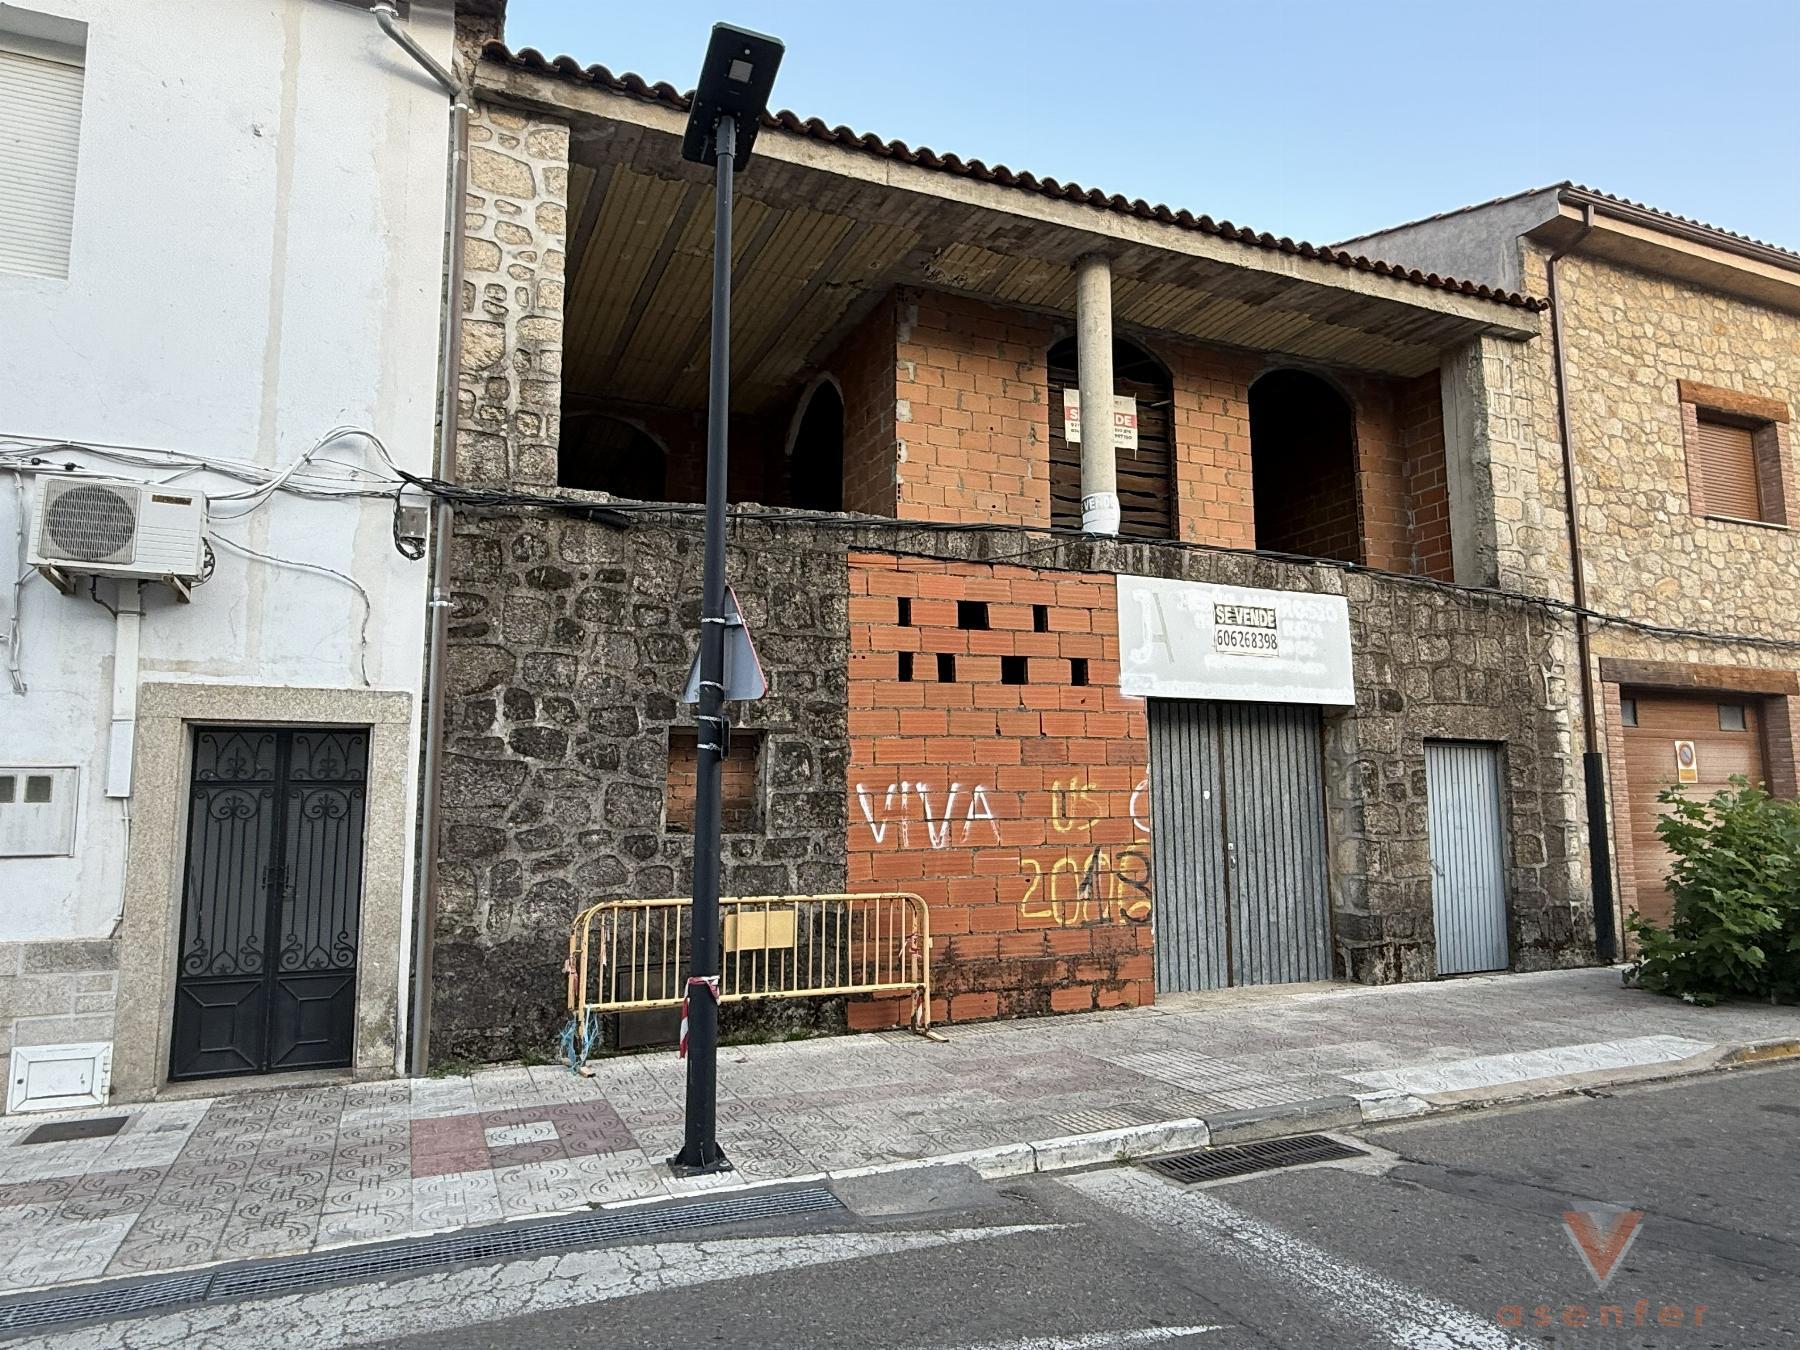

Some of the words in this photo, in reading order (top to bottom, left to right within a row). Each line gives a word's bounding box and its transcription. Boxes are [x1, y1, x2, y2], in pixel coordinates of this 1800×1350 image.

[1216, 605, 1234, 624] SE
[1235, 608, 1276, 627] VENDE
[1216, 629, 1278, 650] 606268398
[856, 781, 1000, 849] VIVA
